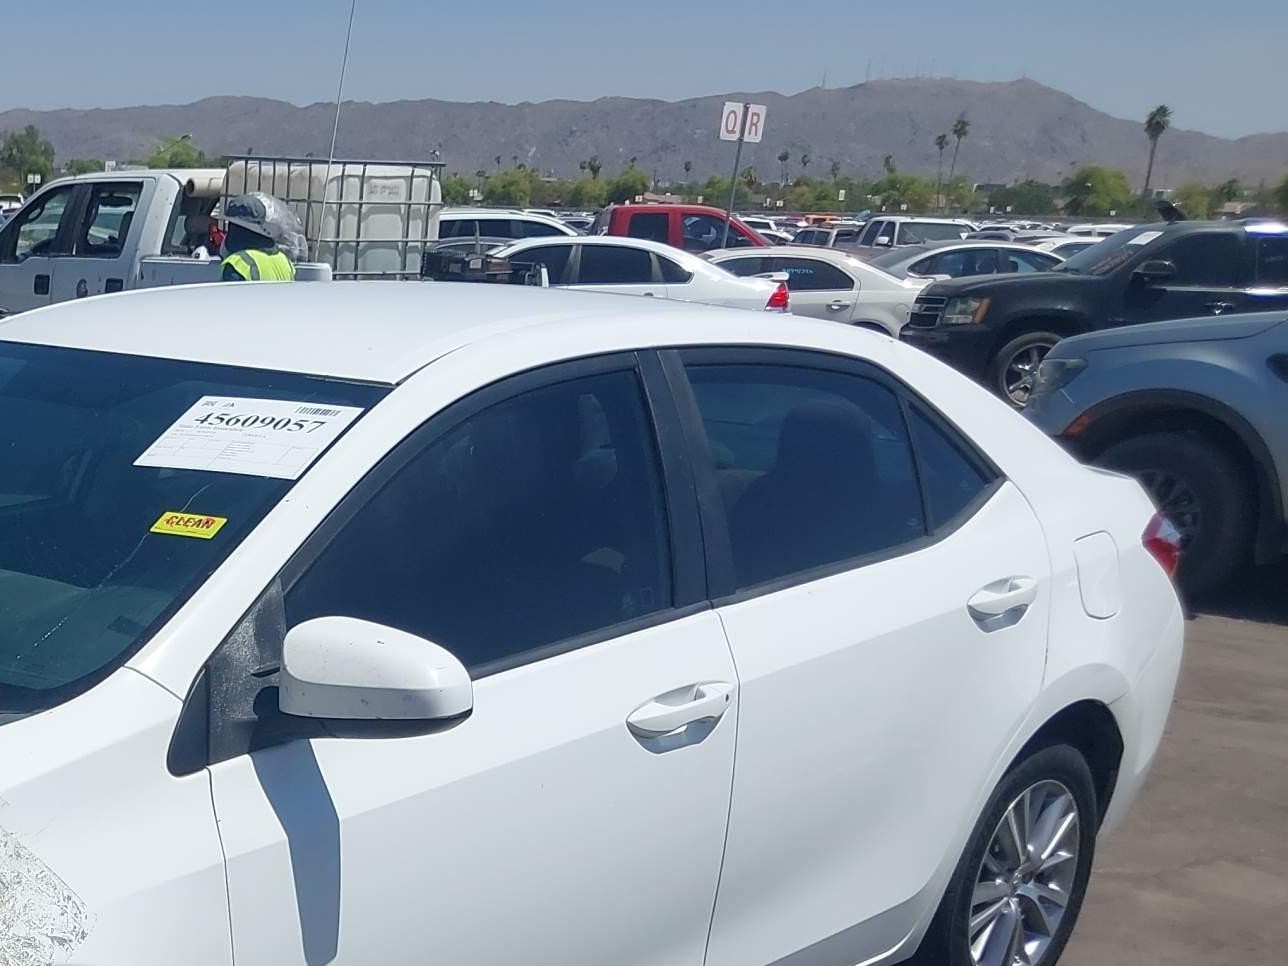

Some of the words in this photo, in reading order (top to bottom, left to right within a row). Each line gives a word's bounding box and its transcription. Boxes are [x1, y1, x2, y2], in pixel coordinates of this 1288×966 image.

[725, 109, 738, 135] Q
[748, 112, 761, 137] R
[194, 411, 328, 434] 45609057
[166, 515, 214, 529] CLEAN
